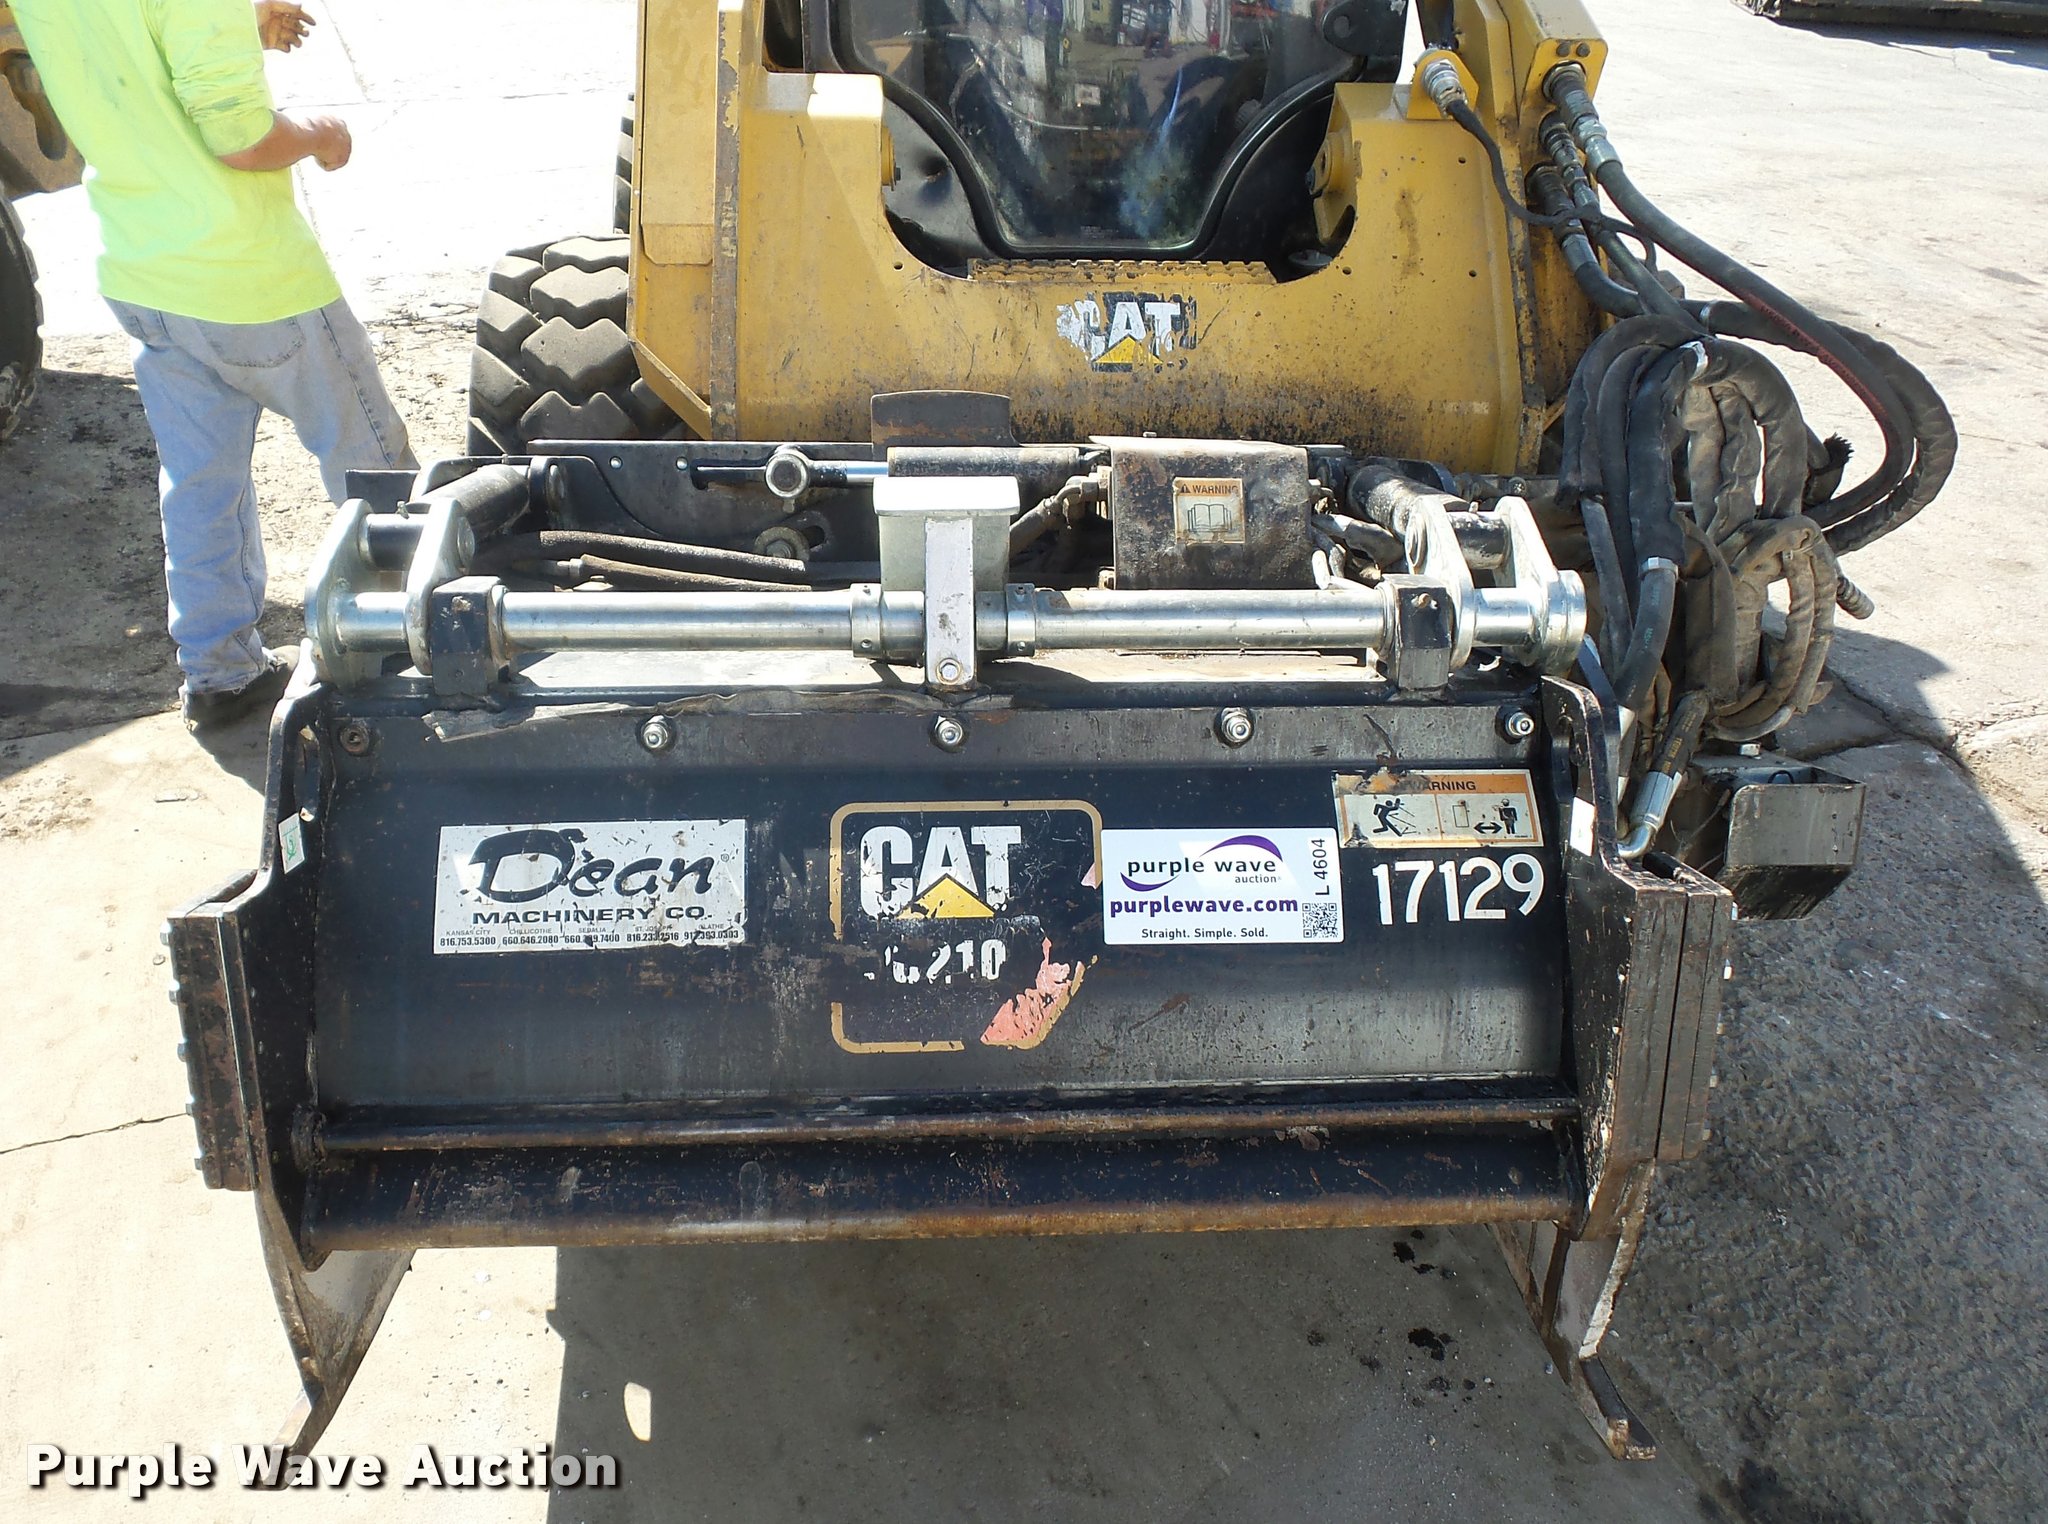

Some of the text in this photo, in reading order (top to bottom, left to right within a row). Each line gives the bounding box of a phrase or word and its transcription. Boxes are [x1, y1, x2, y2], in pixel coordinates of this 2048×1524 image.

[1056, 299, 1181, 362] CAT
[1192, 485, 1239, 495] WARNING
[468, 828, 715, 903] Dean
[860, 825, 1022, 920] CAT
[1127, 857, 1277, 877] purple wave
[1310, 838, 1330, 896] L 4604
[1234, 873, 1277, 884] auction
[1371, 853, 1545, 926] 17129
[472, 907, 654, 925] MACHINERY
[1110, 895, 1298, 918] purplewave.com
[1141, 927, 1269, 941] Straight. Simple. Sold.
